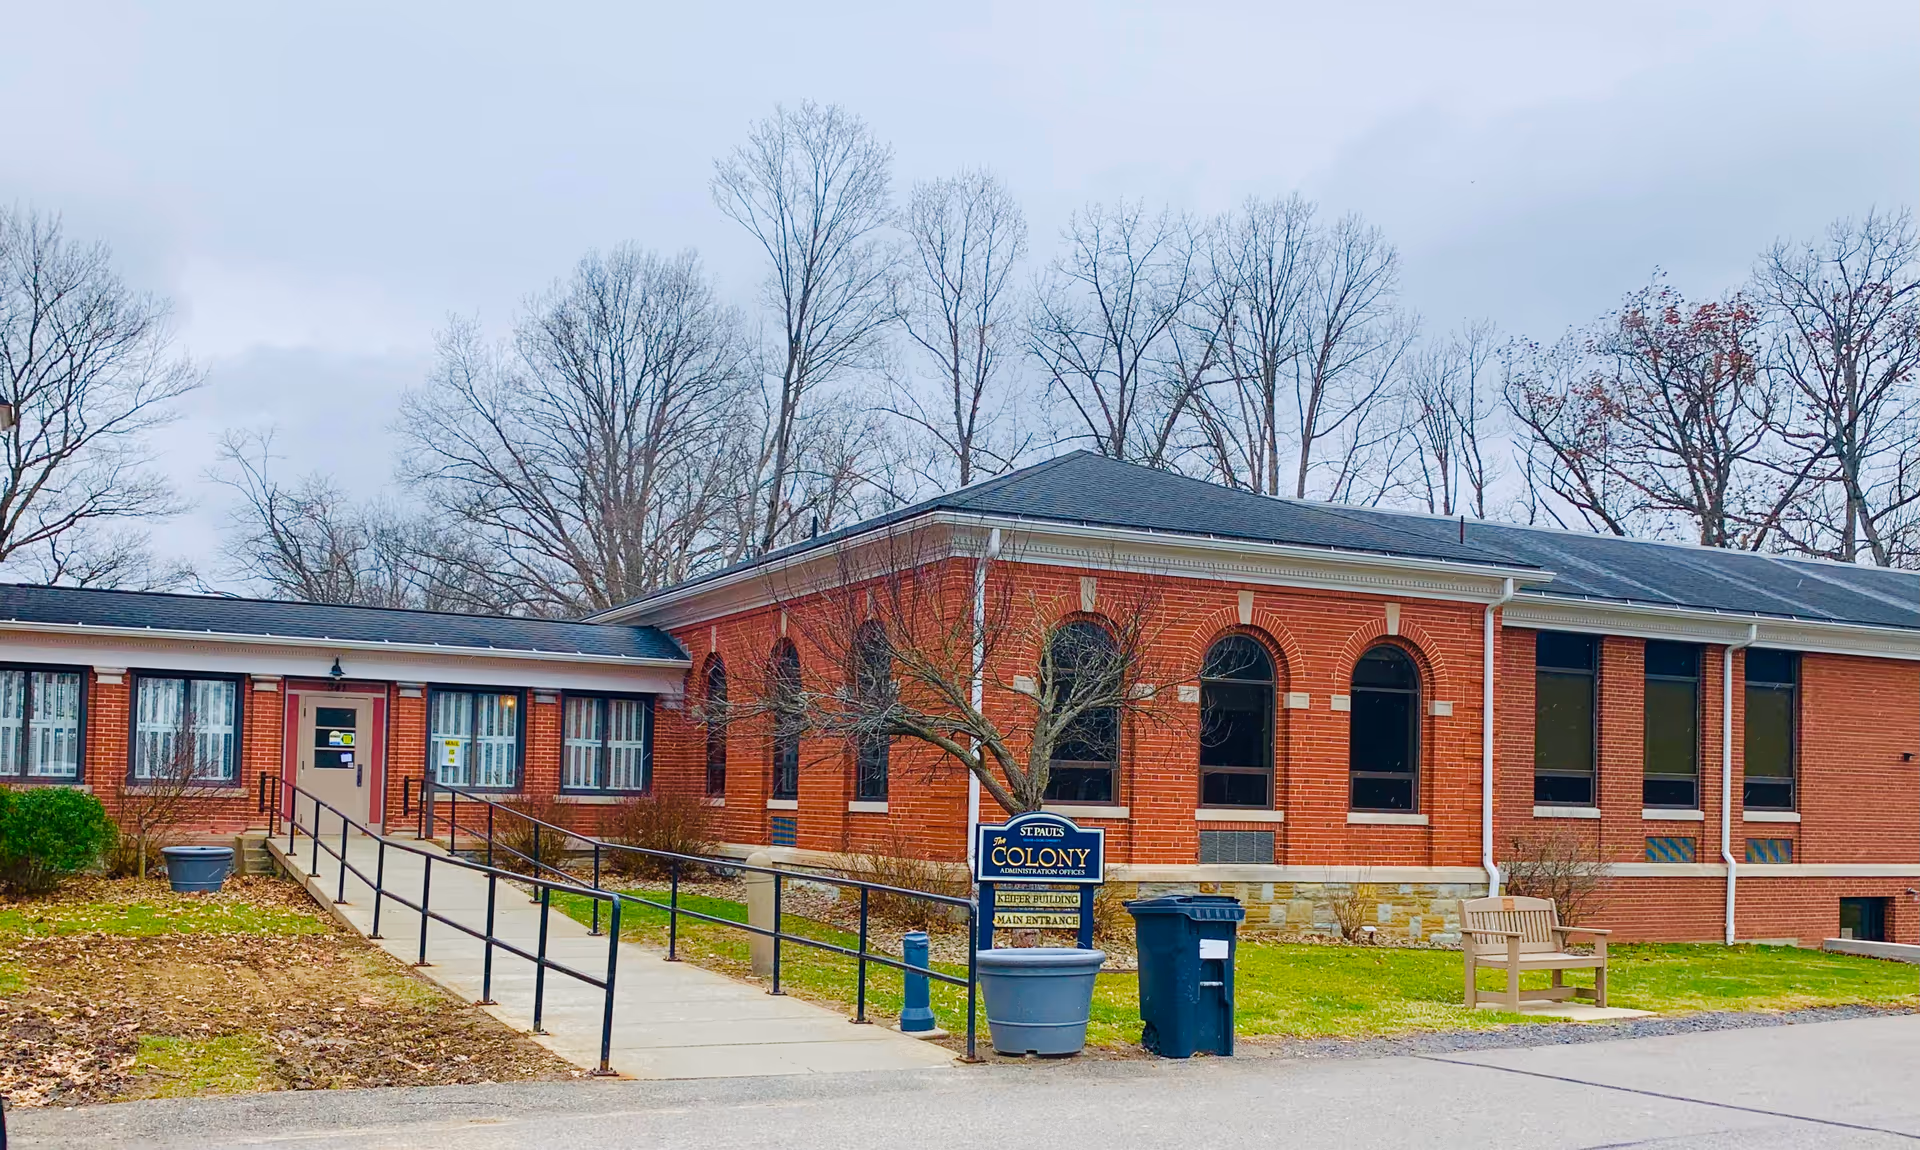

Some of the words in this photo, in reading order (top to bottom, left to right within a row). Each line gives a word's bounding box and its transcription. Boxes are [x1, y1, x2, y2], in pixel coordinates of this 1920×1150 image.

[1034, 827, 1064, 837] PAUL'S
[993, 836, 1006, 846] The
[991, 846, 1091, 867] COLONY
[997, 894, 1031, 903] KEIFER
[1033, 895, 1078, 904] BUILDING
[997, 915, 1024, 925] MAIN
[1025, 915, 1078, 925] ENTRANCE
